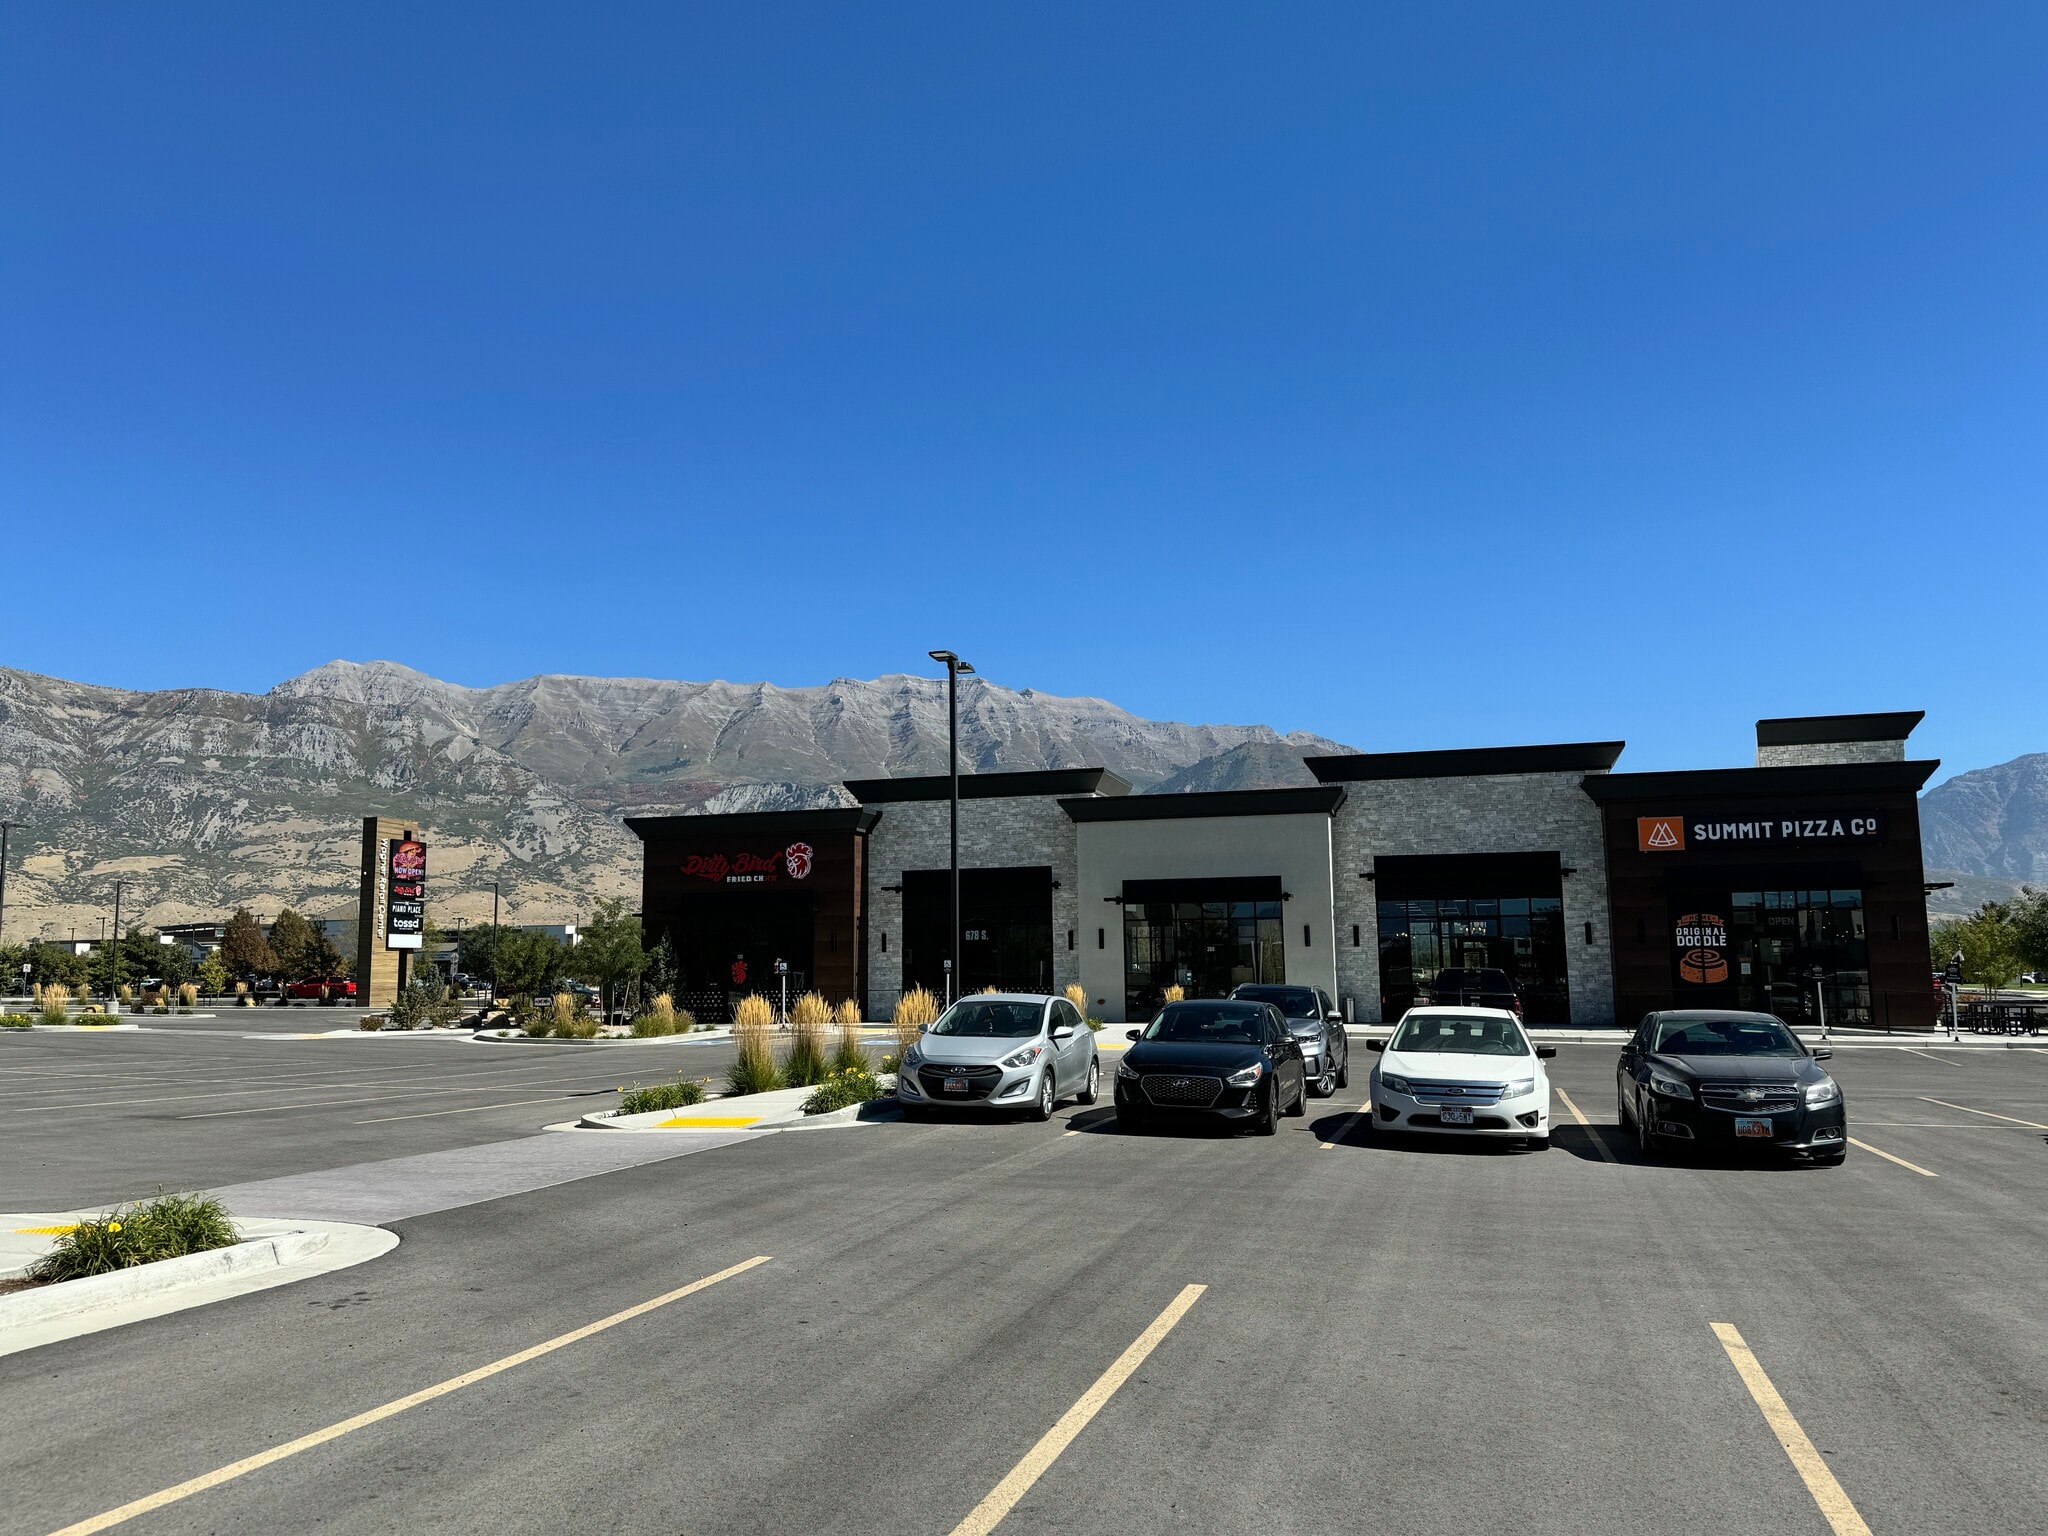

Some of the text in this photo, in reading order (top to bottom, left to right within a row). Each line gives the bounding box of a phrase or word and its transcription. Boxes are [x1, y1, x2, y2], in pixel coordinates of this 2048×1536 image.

[1693, 821, 1773, 841] SUMMIT
[1781, 818, 1845, 838] PIZZA
[680, 851, 783, 881] Dirty Bird
[392, 905, 421, 914] PIANO PLACE
[377, 905, 385, 940] Center
[393, 917, 419, 928] tossd
[1768, 917, 1795, 926] OPEN
[965, 930, 979, 940] 678
[1675, 927, 1727, 936] ORIGINAL
[1676, 935, 1727, 946] DOODLE
